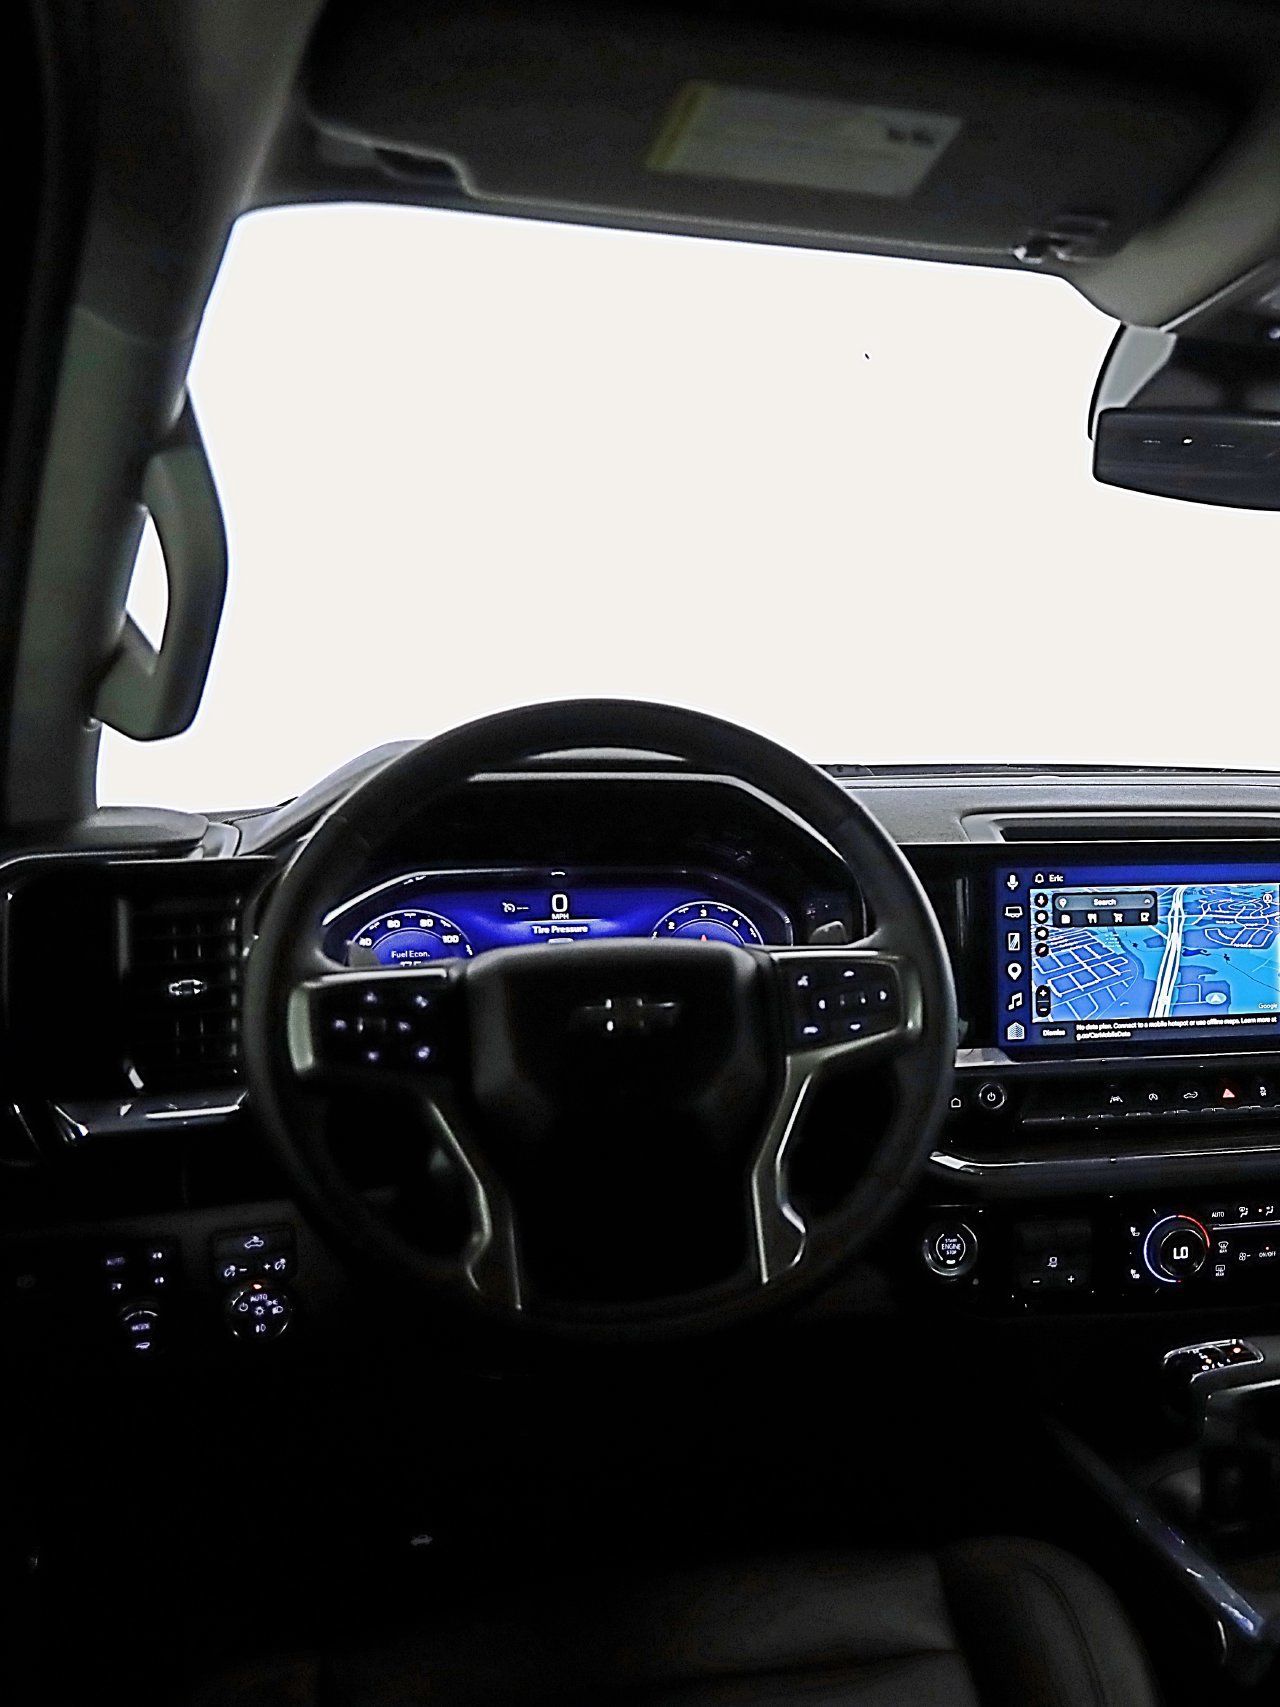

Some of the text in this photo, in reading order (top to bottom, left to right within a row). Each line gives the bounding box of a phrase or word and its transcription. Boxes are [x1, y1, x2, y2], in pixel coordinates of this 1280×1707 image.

[1048, 874, 1064, 882] Eric
[552, 893, 568, 913] 0
[1093, 898, 1117, 906] Search
[531, 925, 588, 935] Tire Pressure
[668, 921, 675, 930] 2
[442, 934, 460, 944] 100
[391, 950, 431, 959] Fuel Econ.
